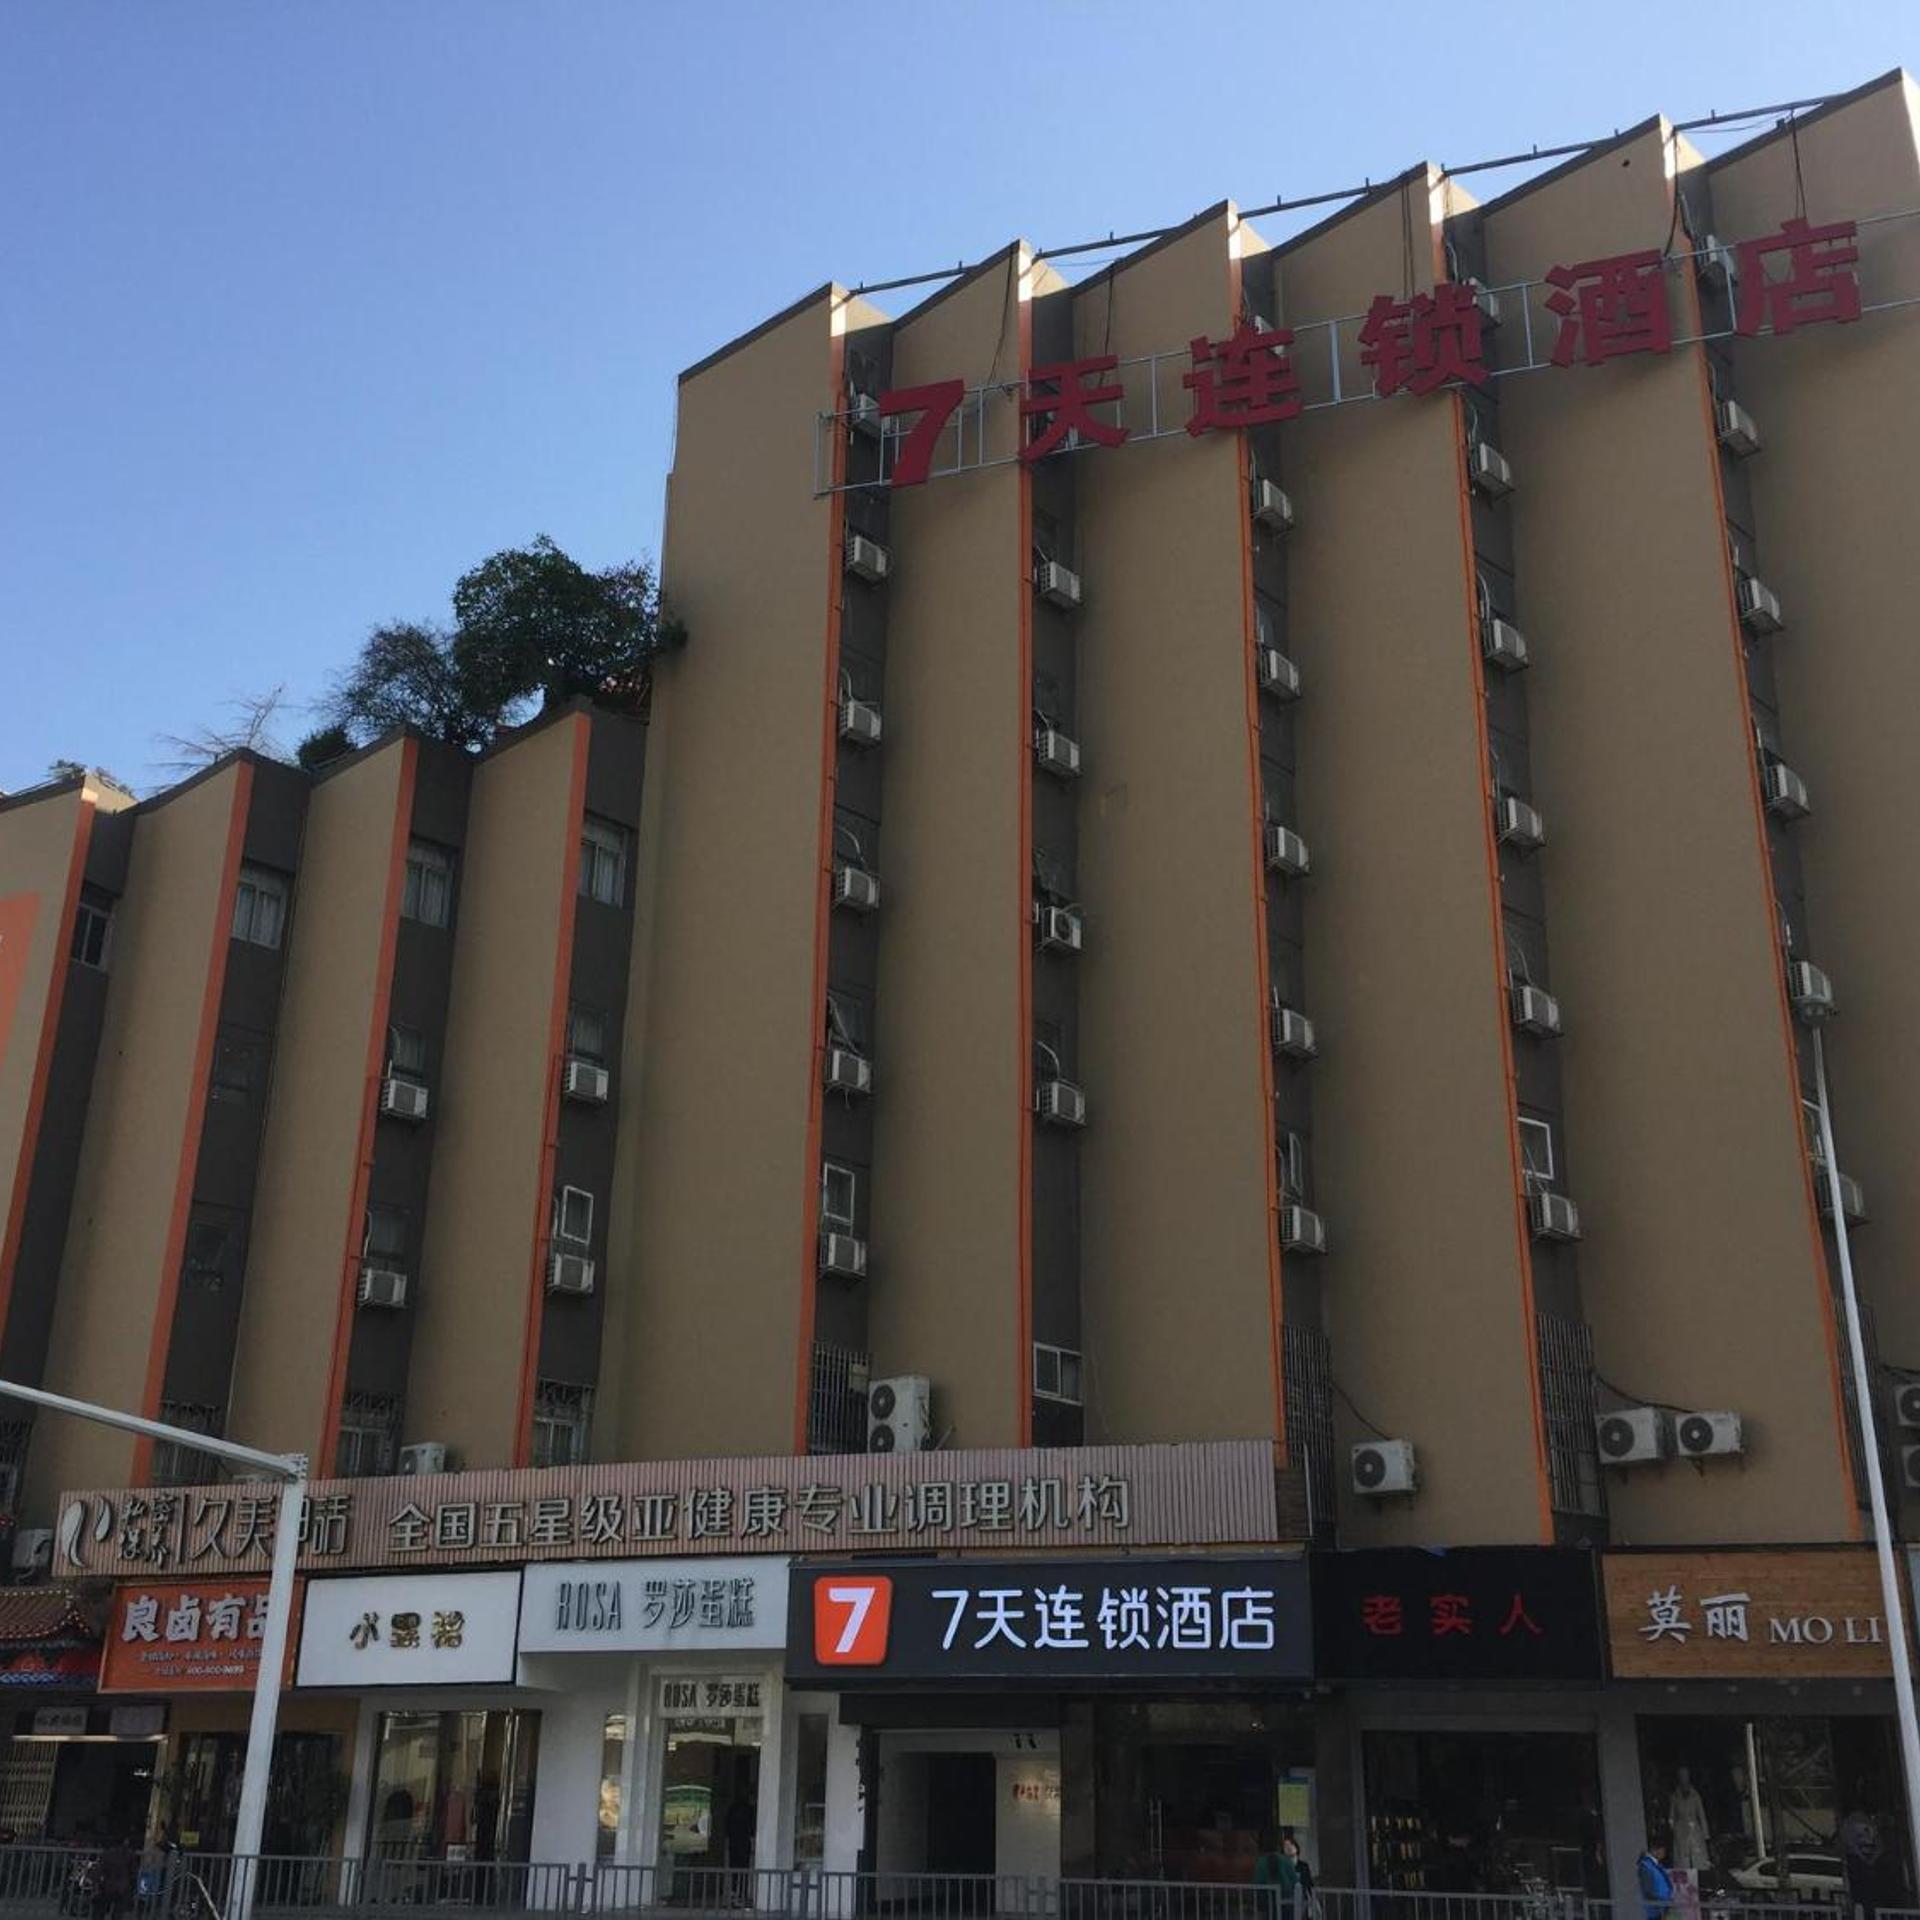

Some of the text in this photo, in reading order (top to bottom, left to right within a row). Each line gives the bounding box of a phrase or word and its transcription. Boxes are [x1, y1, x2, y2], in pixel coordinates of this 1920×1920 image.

[880, 217, 1863, 487] 7天连锁酒店
[388, 1474, 1130, 1551] 全国五星级亚健康专业调理机构
[556, 1578, 755, 1631] ROSA 罗莎蛋糕
[828, 1587, 875, 1653] 7
[931, 1584, 1275, 1651] 7天连锁酒店
[1361, 1593, 1543, 1637] 老实人
[1639, 1585, 1882, 1644] 莫丽 MO LI
